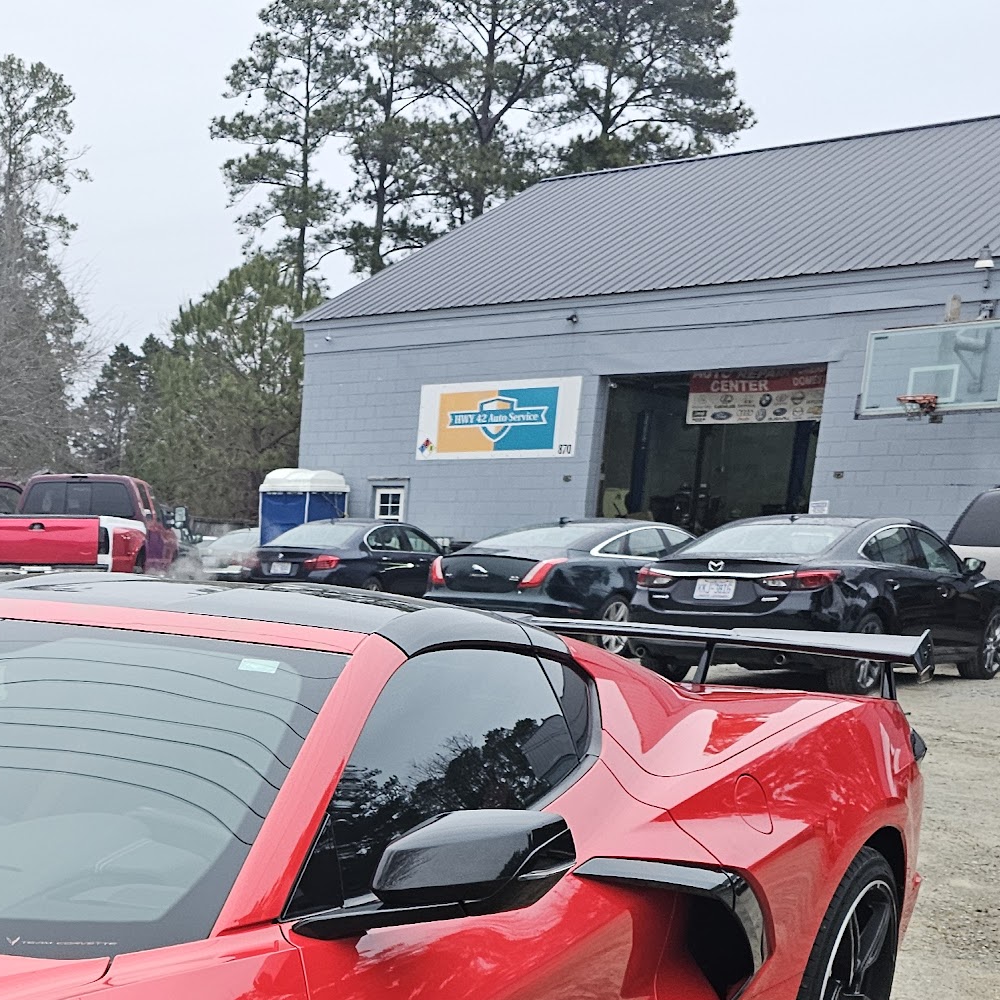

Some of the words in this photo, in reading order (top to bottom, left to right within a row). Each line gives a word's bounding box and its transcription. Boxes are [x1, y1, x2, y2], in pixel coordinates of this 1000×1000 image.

[710, 379, 769, 392] CENTER
[454, 414, 475, 424] HWY
[476, 413, 488, 423] 42
[488, 413, 508, 422] Auto
[509, 412, 539, 421] Service
[558, 444, 571, 454] 870
